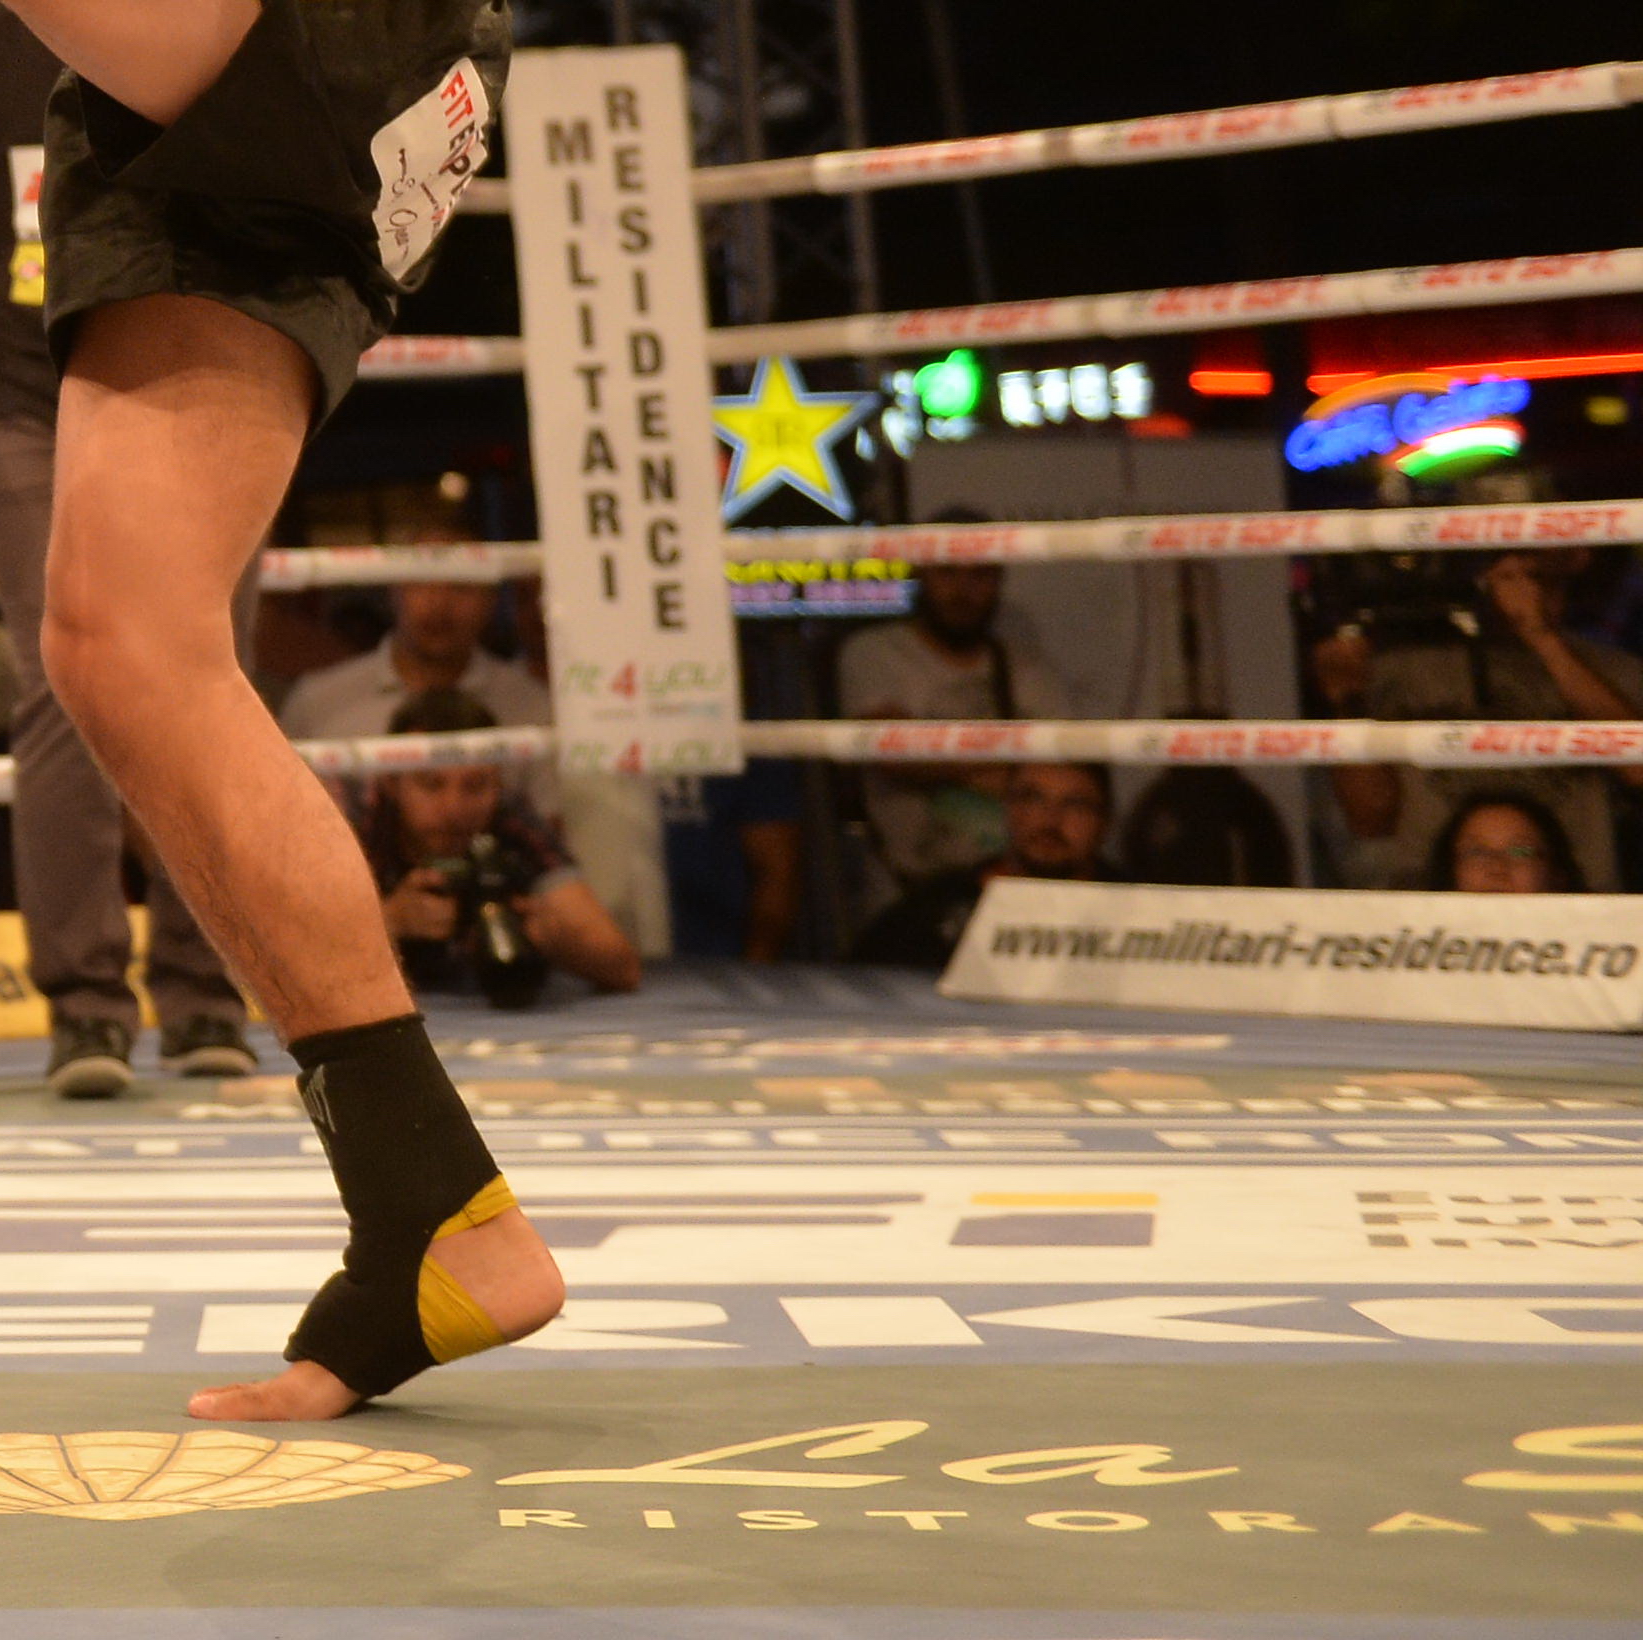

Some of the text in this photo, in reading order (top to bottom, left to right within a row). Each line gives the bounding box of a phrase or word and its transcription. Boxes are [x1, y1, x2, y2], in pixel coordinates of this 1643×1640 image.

[544, 120, 627, 602] MILITARI
[604, 85, 685, 632] RESIDENCE
[988, 920, 1639, 980] www.militari-residence.ro
